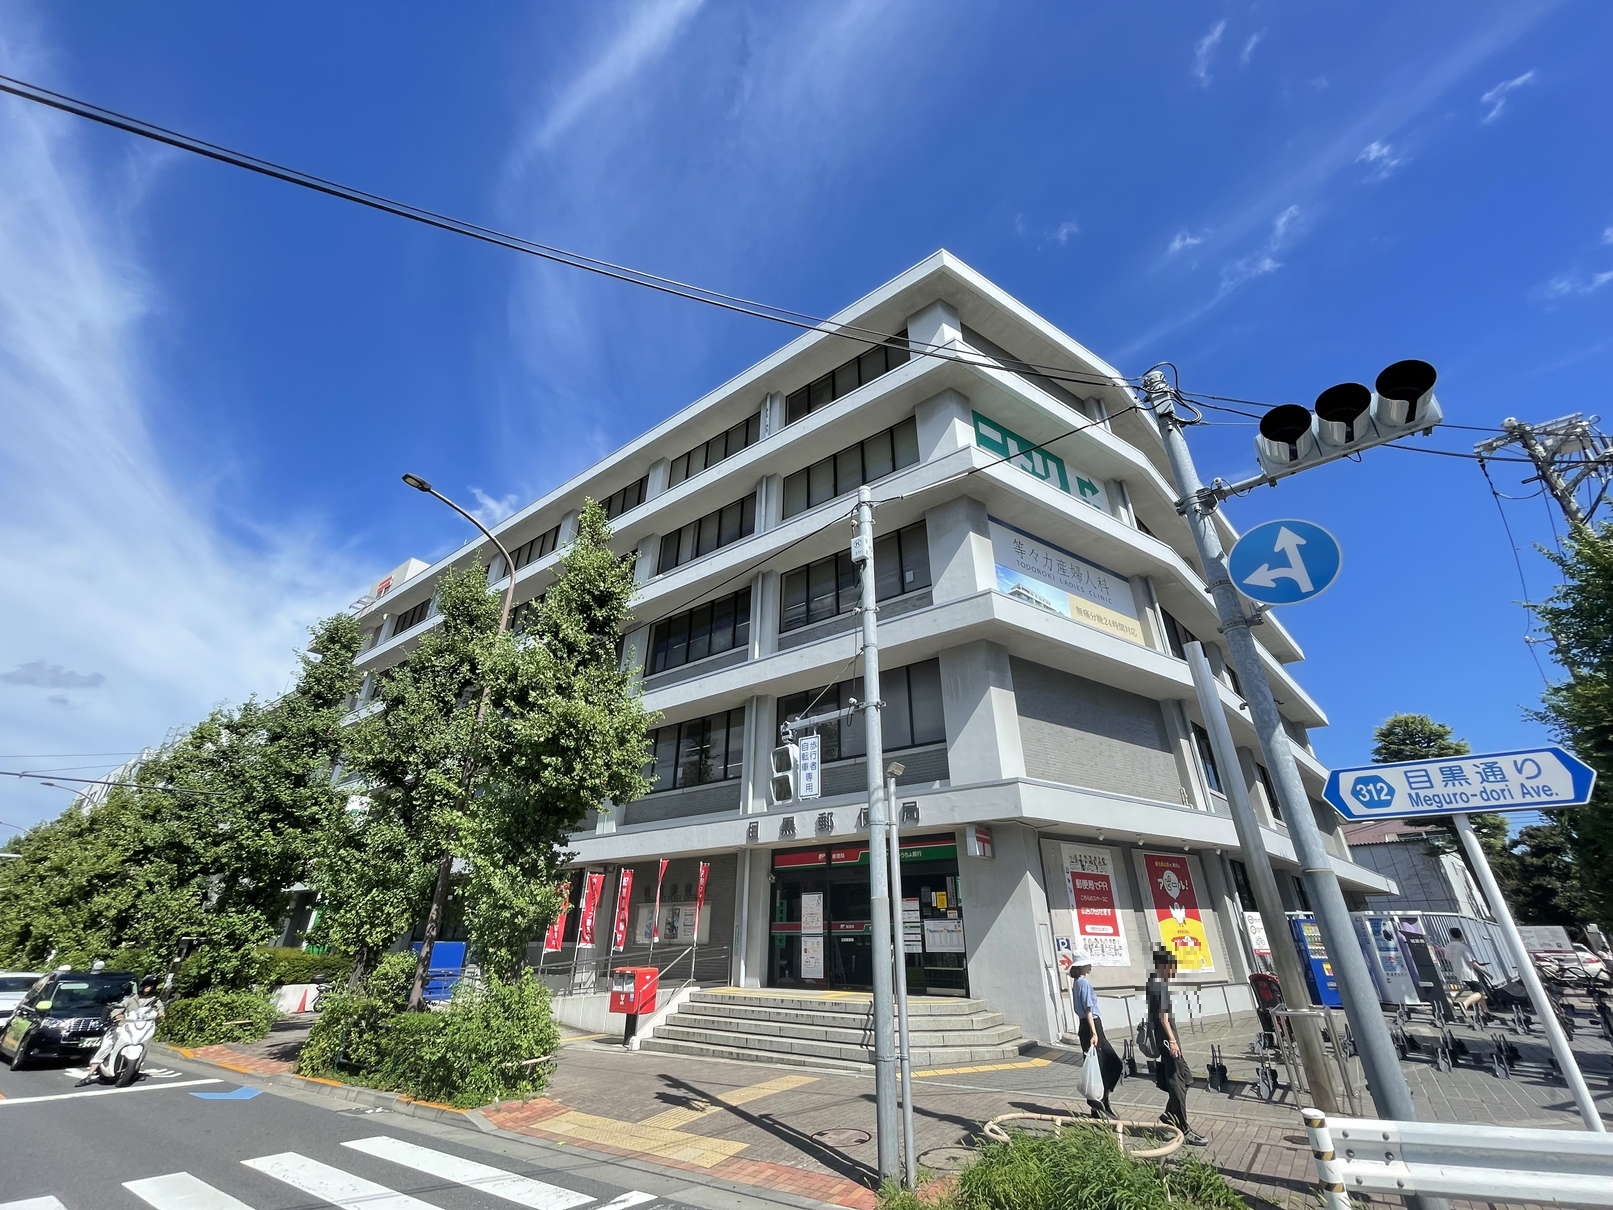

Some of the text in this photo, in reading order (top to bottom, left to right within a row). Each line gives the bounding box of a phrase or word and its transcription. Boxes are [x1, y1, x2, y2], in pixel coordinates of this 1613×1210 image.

[1011, 538, 1110, 595] 等々力産婦人科
[1089, 591, 1113, 605] CLINIC
[1404, 758, 1542, 790] 目黒通り
[1355, 782, 1392, 802] 312
[1407, 782, 1559, 809] Meguro-dori Ave.
